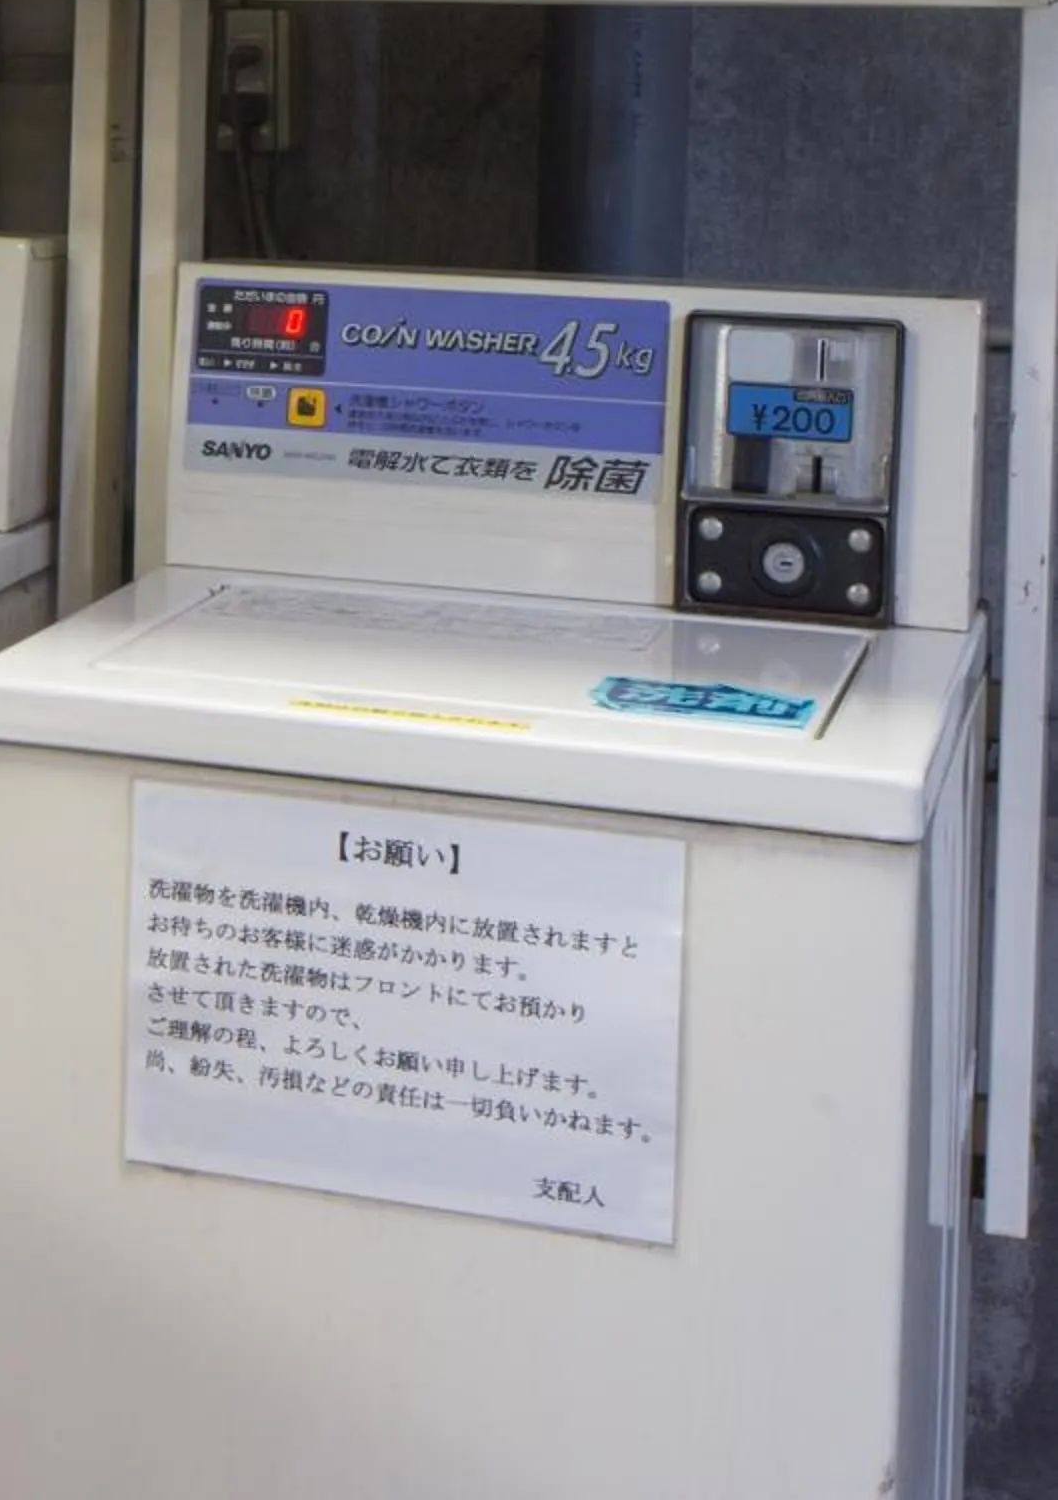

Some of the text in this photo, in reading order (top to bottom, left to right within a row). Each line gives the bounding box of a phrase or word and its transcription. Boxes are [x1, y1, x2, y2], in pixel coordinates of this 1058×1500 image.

[285, 308, 304, 335] 0
[426, 328, 538, 357] WASHER
[751, 403, 836, 436] ¥200
[202, 439, 272, 462] SANYO
[544, 454, 651, 497] 除菌
[336, 830, 461, 876] 【お願い】
[534, 1176, 606, 1208] 支配人
